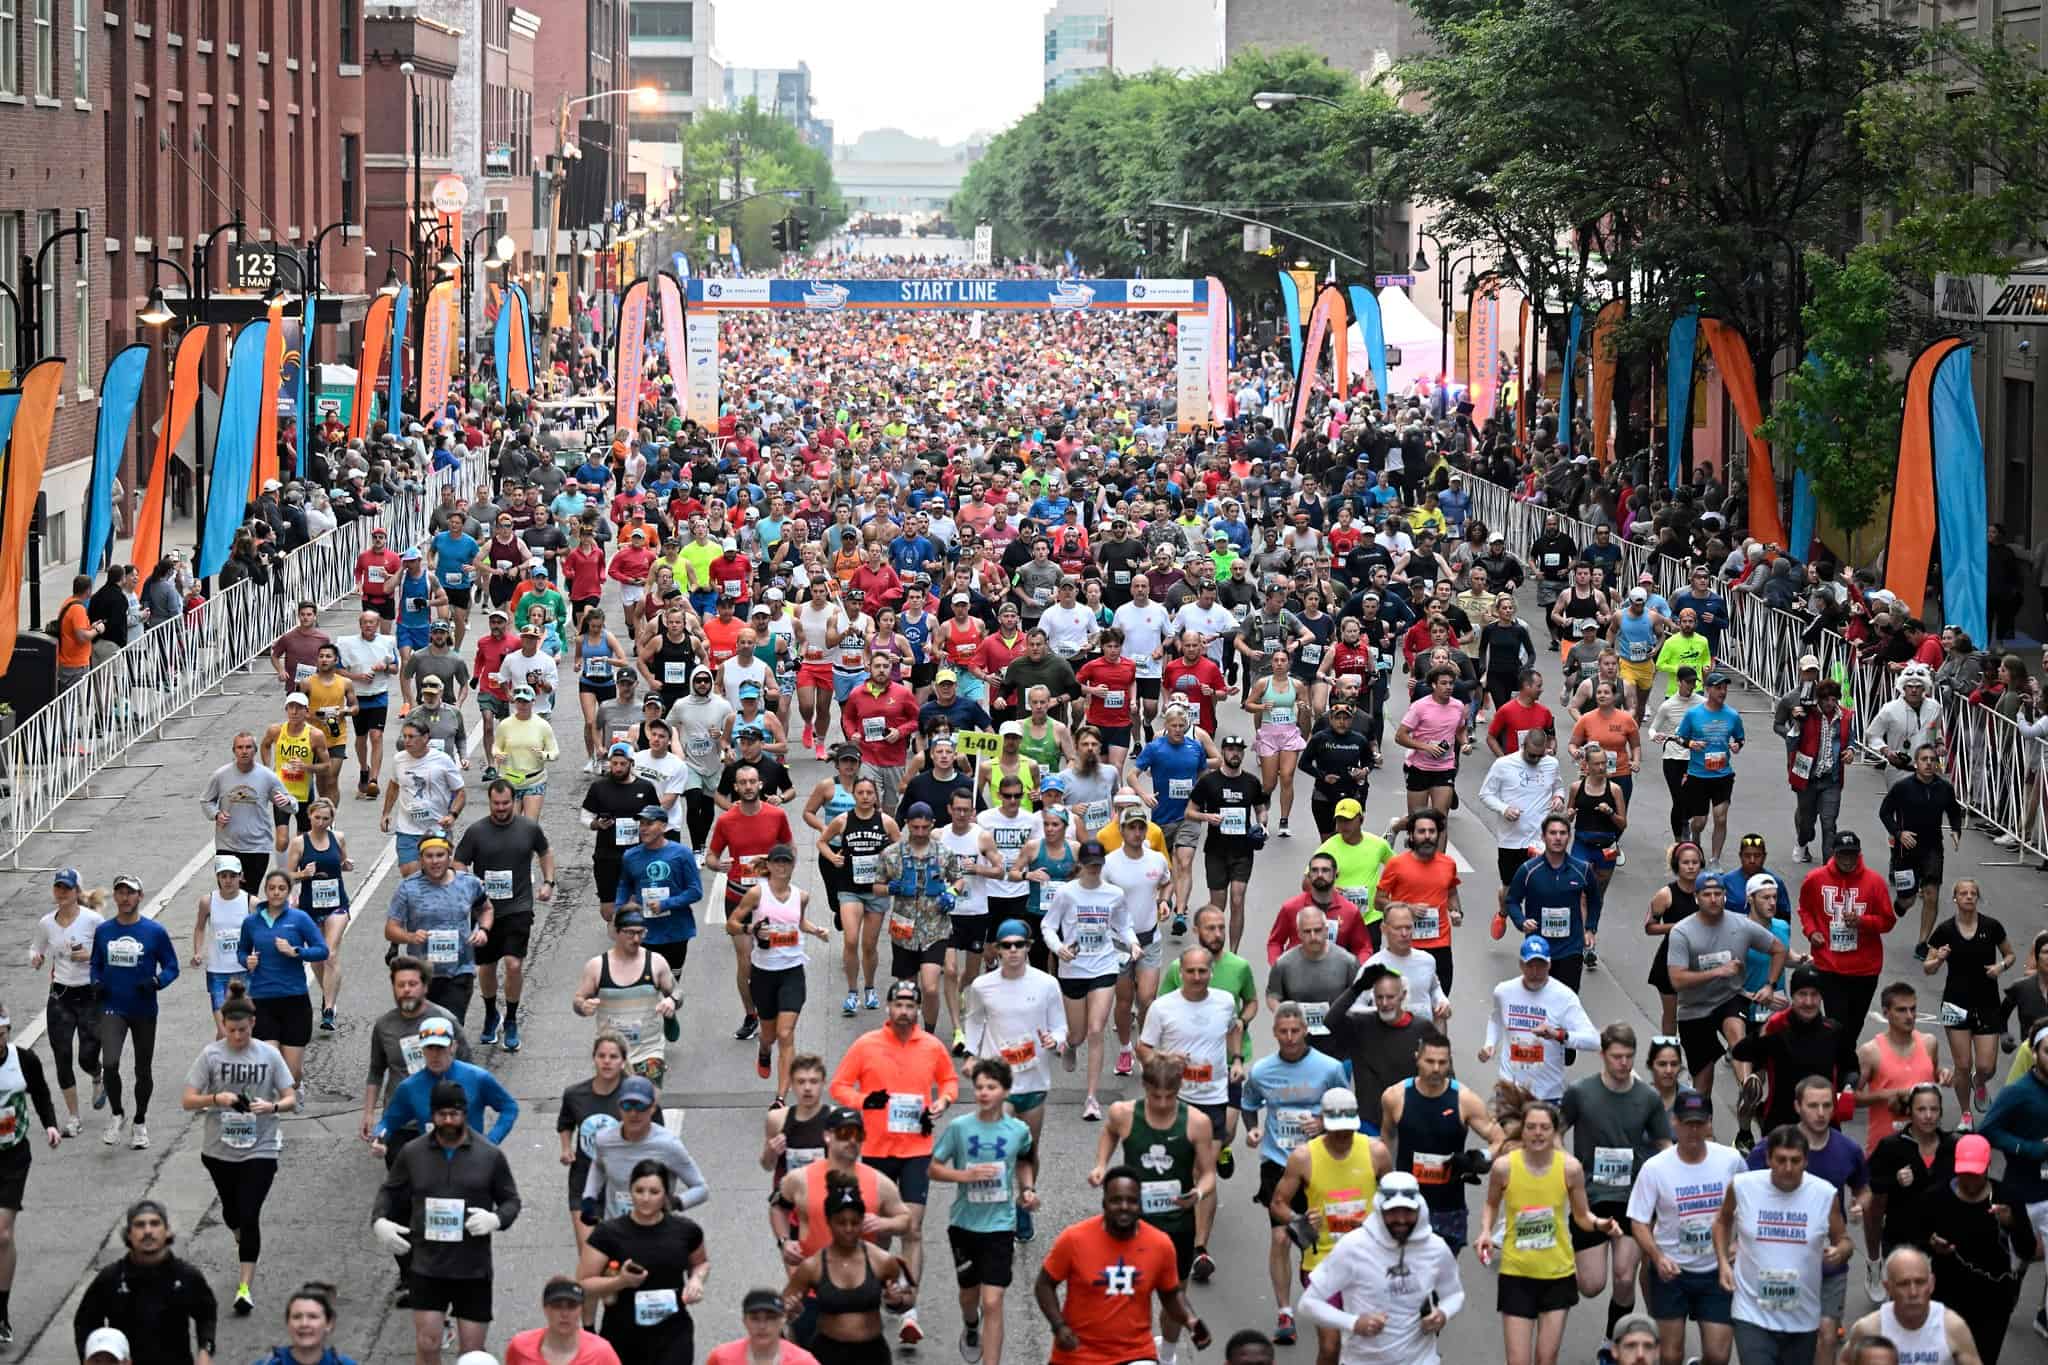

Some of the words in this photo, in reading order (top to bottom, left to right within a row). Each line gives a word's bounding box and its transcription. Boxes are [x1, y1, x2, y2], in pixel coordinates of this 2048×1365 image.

[236, 254, 276, 276] 123
[240, 276, 246, 287] E
[901, 282, 953, 300] START
[958, 282, 997, 300] LINE
[280, 743, 309, 758] MR8
[965, 736, 997, 751] 1:40
[996, 829, 1030, 843] DICK'S
[1509, 1004, 1529, 1014] TODDS
[1529, 1006, 1547, 1016] ROAD
[221, 1063, 269, 1085] FIGHT
[1676, 1185, 1700, 1197] TODDS
[1700, 1182, 1723, 1194] ROAD
[1678, 1198, 1723, 1211] STUMBLERS
[1758, 1210, 1784, 1222] TODDS
[1786, 1211, 1808, 1223] ROAD
[1757, 1226, 1806, 1239] STUMBLERS
[1105, 1266, 1136, 1296] H
